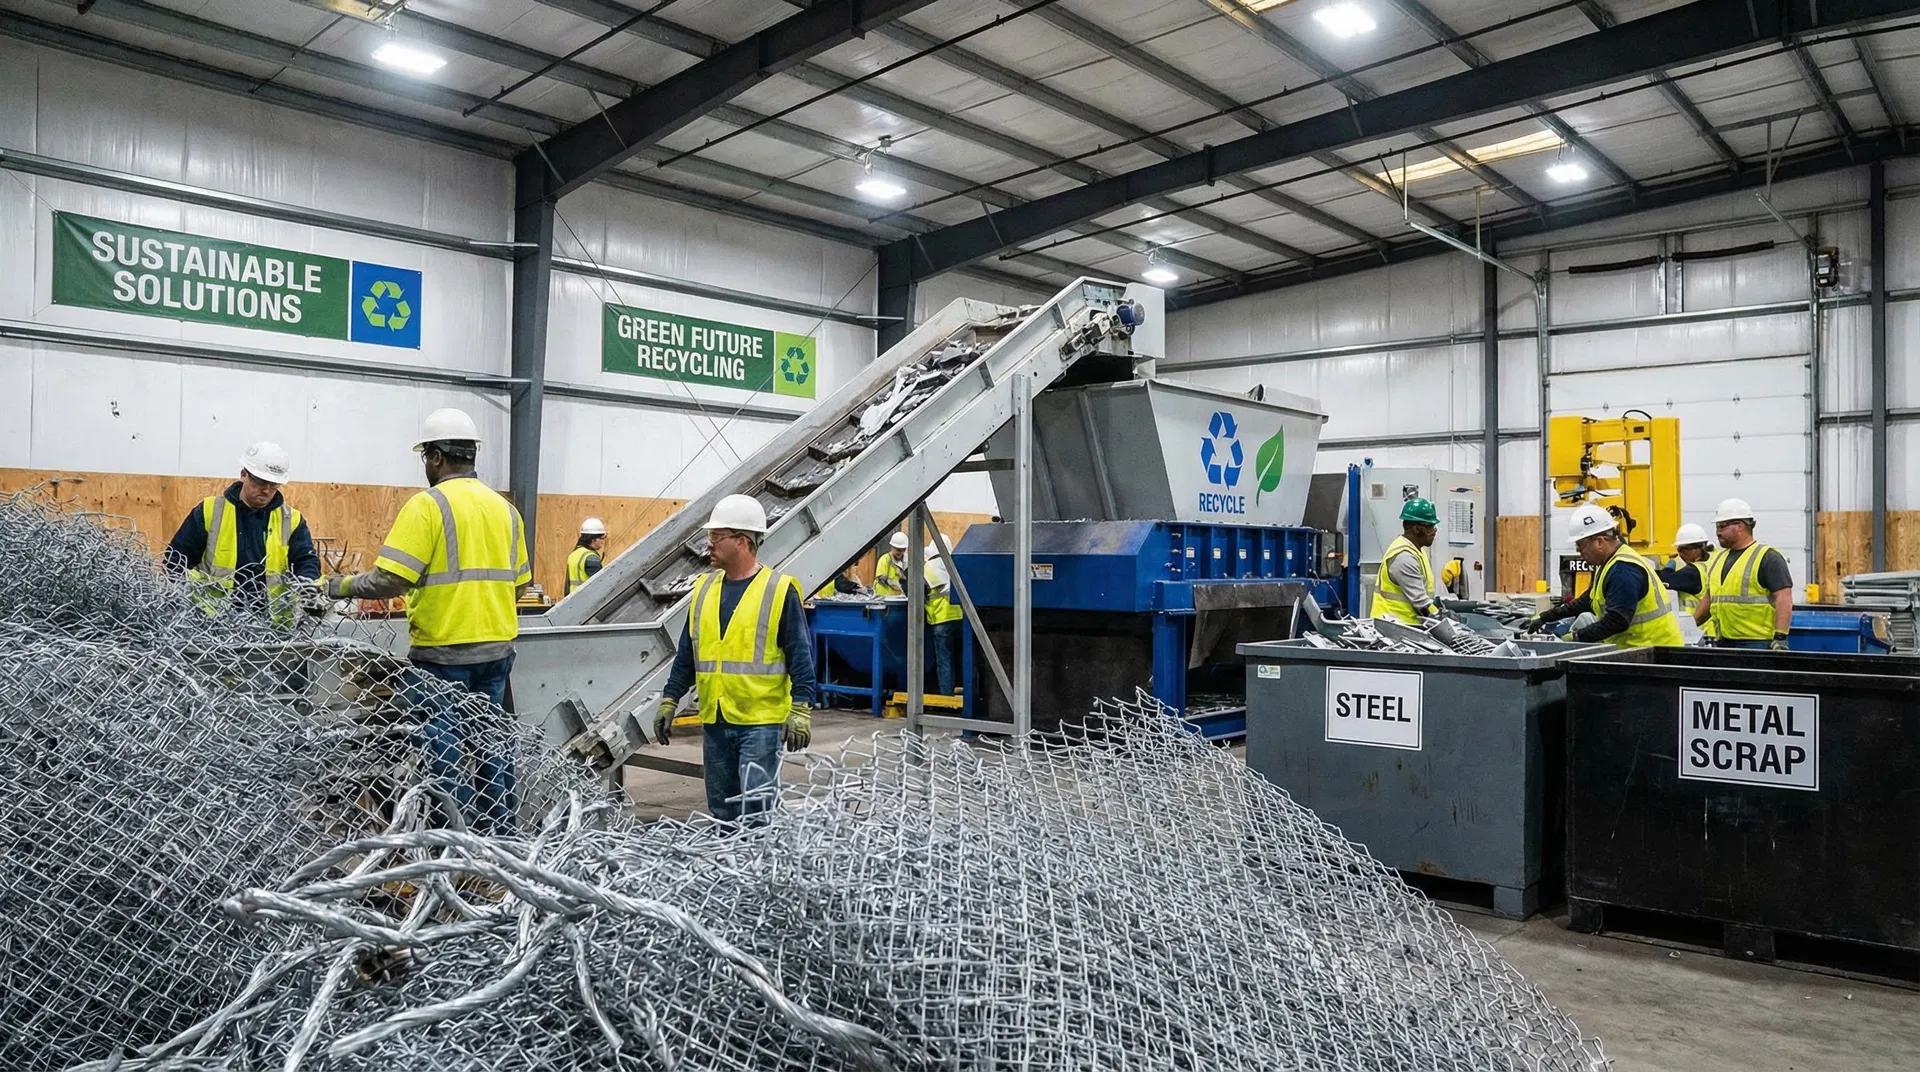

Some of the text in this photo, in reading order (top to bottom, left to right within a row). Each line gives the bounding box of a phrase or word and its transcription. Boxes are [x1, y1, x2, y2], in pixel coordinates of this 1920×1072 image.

[91, 230, 322, 294] SUSTAINABLE
[112, 270, 302, 324] SOLUTIONS
[617, 314, 764, 359] GREEN FUTURE
[637, 343, 745, 381] RECYCLING
[1199, 493, 1245, 514] RECYCLE
[1336, 692, 1411, 723] STEEL
[1692, 700, 1806, 738] METAL
[1690, 737, 1806, 776] SCRAP
